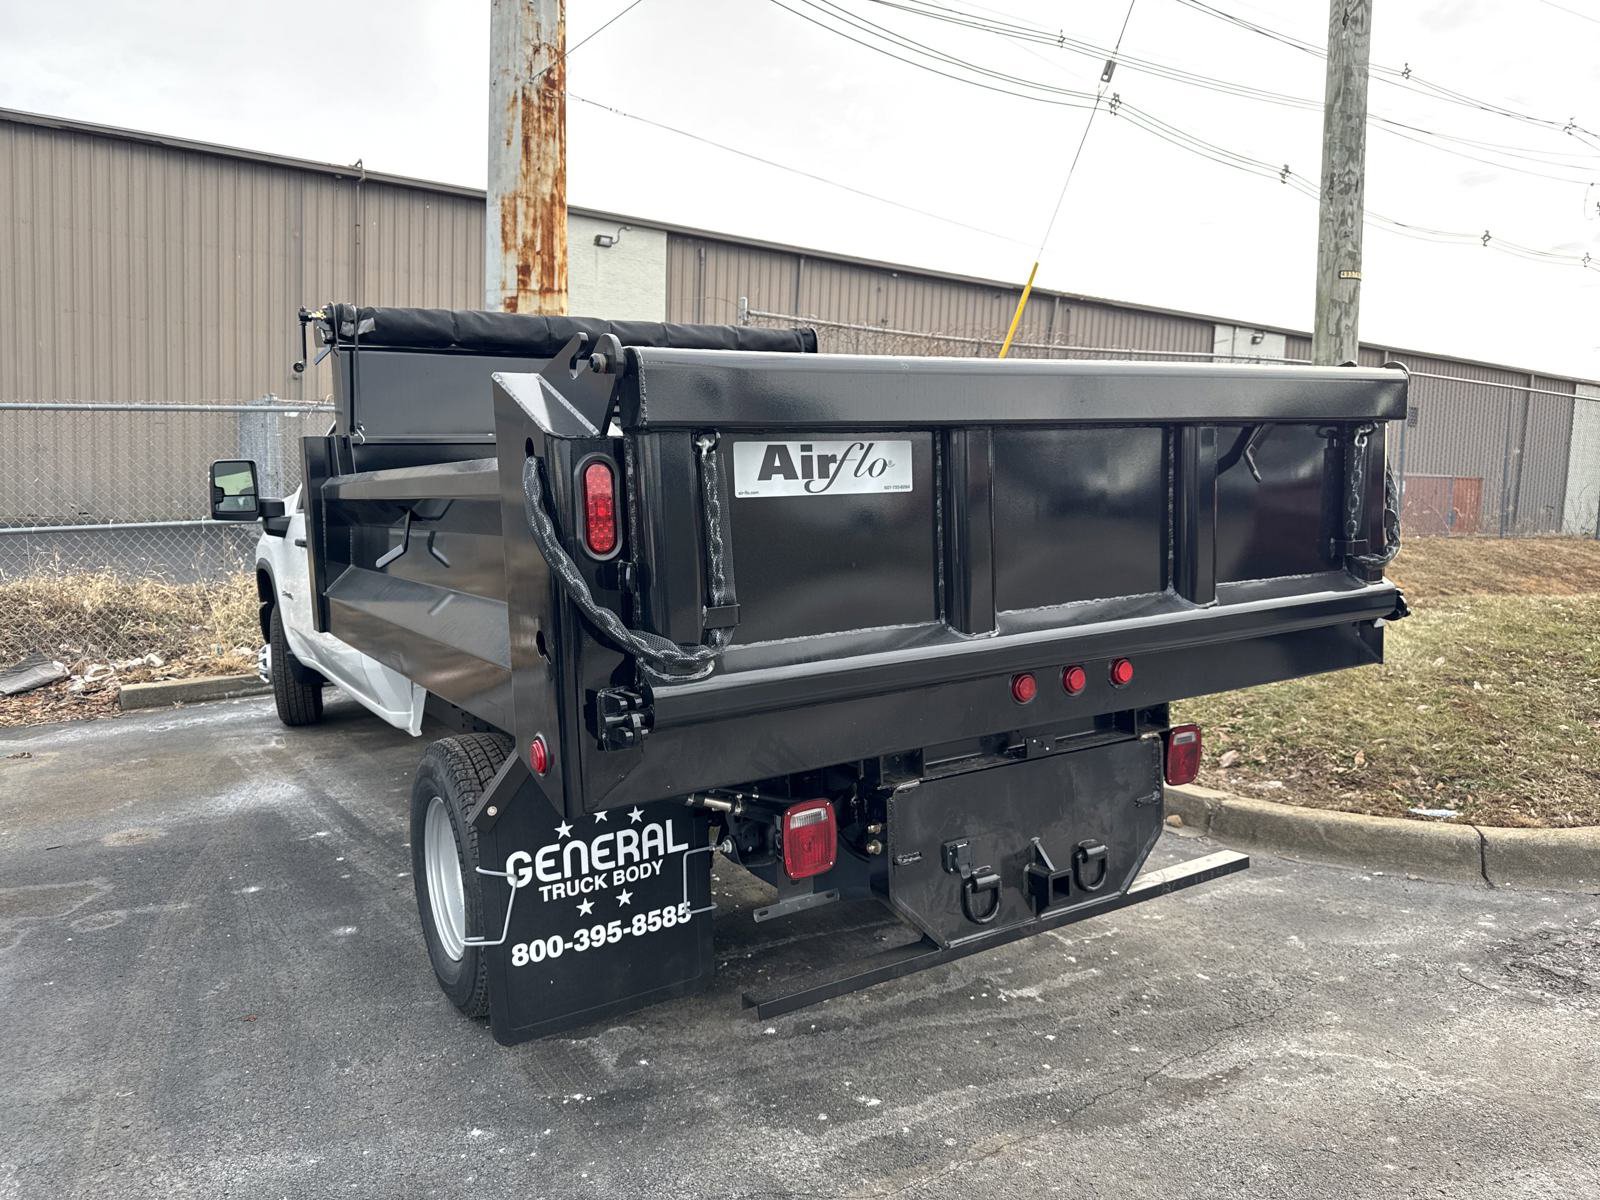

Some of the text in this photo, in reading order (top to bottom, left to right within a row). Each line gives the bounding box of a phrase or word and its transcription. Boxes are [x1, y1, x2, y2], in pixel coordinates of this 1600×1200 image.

[505, 819, 689, 888] GENERAL
[538, 859, 663, 902] TRUCK BODY
[511, 901, 692, 967] 800-395-8585
